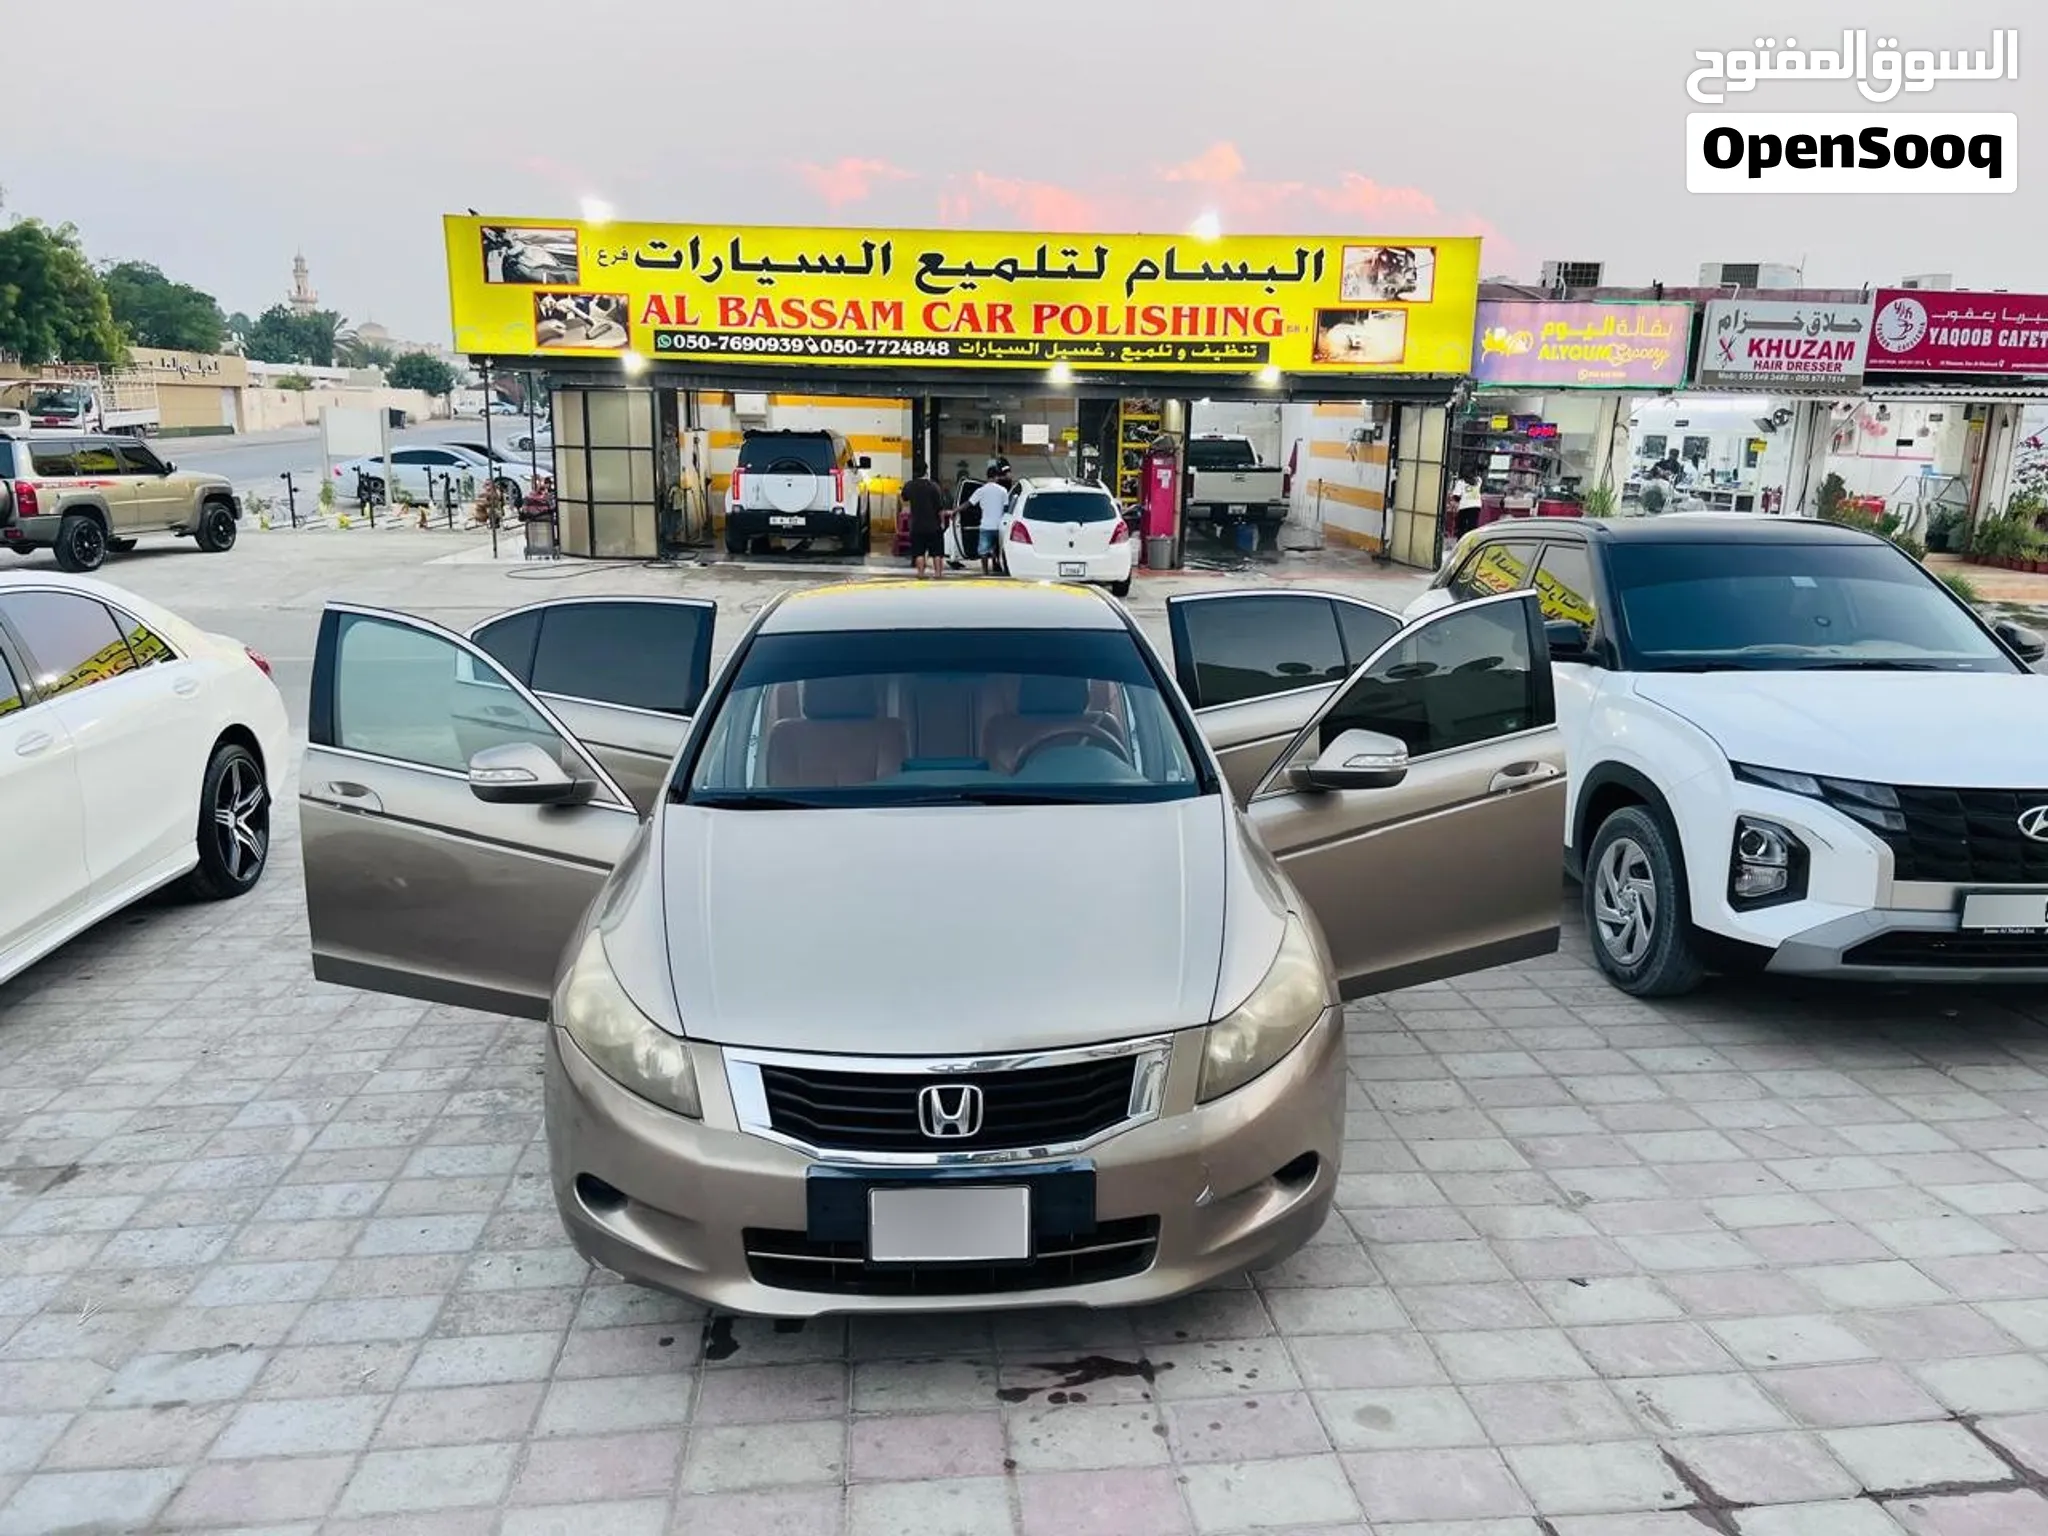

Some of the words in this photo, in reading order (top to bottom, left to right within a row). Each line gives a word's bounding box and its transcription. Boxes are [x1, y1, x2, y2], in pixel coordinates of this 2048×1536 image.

[633, 235, 893, 285] السيارات
[914, 243, 1110, 295] لتلميع
[1125, 246, 1325, 298] البسام
[640, 294, 700, 325] AL
[717, 296, 904, 331] BASSAM
[922, 302, 1014, 333] CAR
[1032, 305, 1285, 337] POLISHING
[1718, 308, 1805, 335] خزام
[1806, 311, 1863, 337] حلاق
[1540, 316, 1616, 341] اليوم
[1929, 328, 1993, 347] YAQOOB
[673, 334, 805, 352] 050-7690939
[820, 339, 951, 356] 050-7724848
[958, 341, 1039, 358] السيارات
[1044, 344, 1106, 359] غسيل
[1120, 344, 1173, 362] تلميع
[1191, 345, 1258, 363] تنظيف
[1538, 344, 1613, 362] ALYOUM
[1747, 338, 1856, 361] KHUZAM
[1754, 360, 1784, 371] HAIR
[1787, 362, 1843, 373] DRESSER
